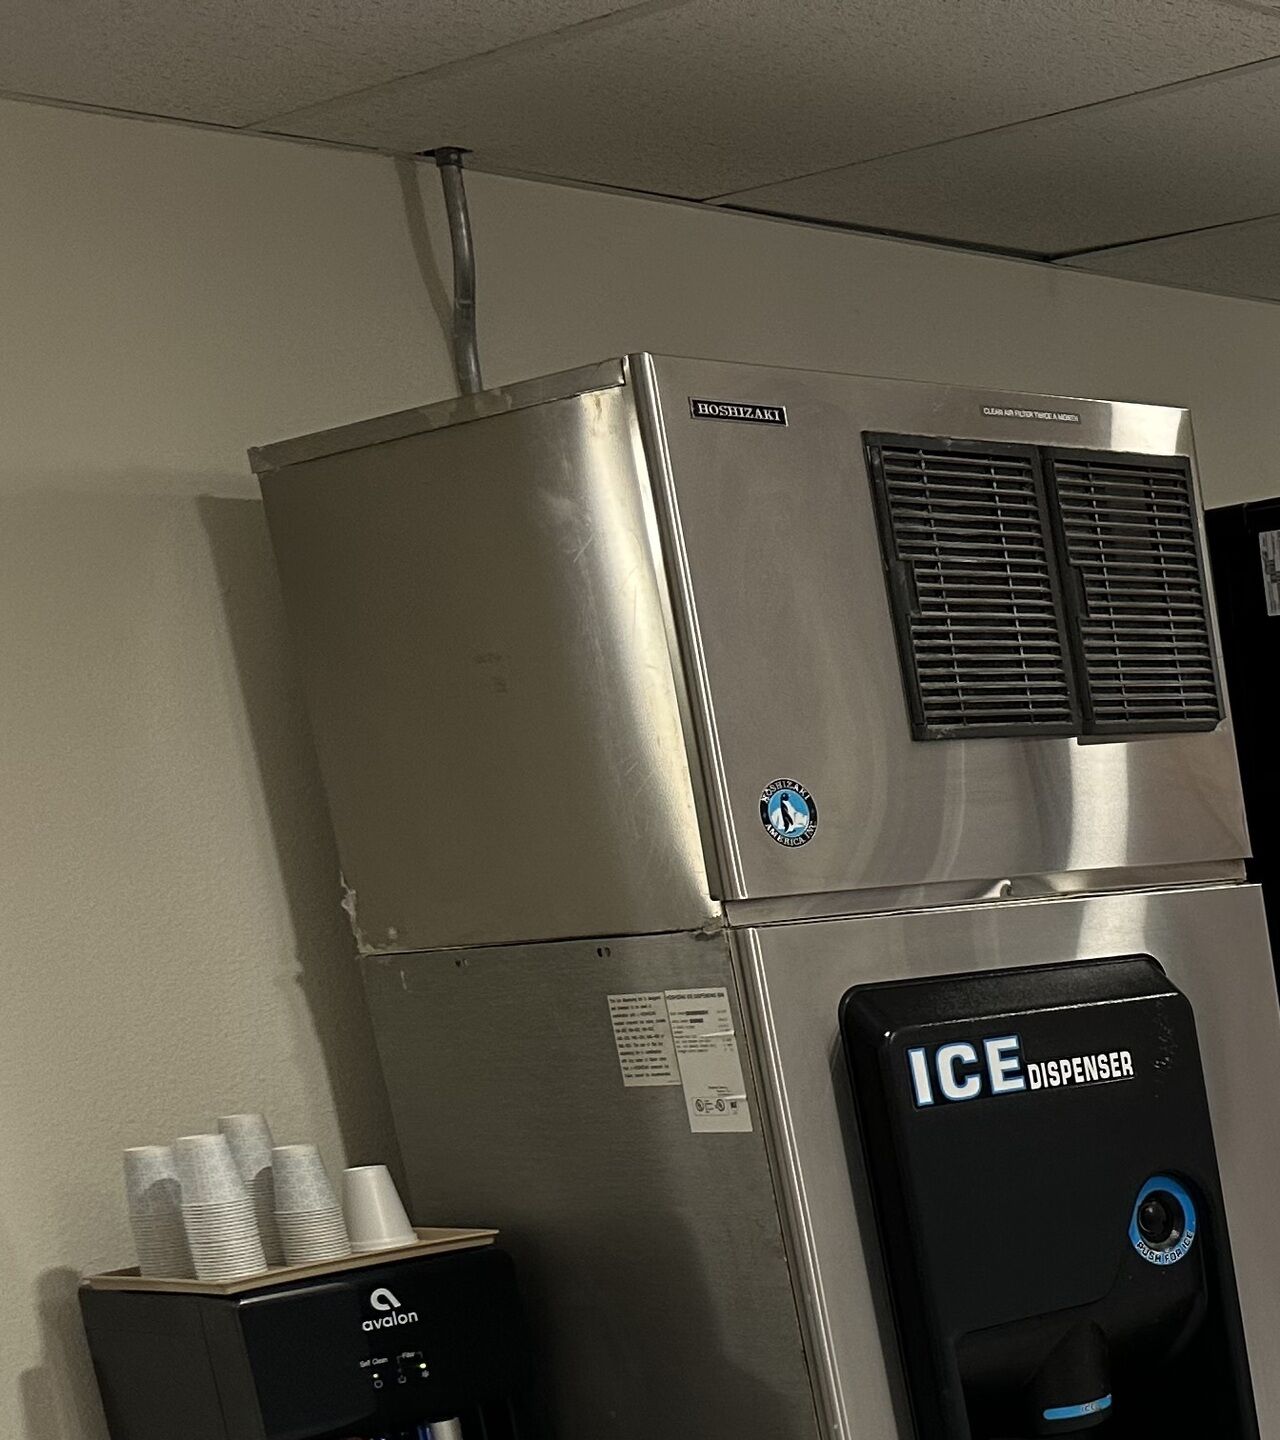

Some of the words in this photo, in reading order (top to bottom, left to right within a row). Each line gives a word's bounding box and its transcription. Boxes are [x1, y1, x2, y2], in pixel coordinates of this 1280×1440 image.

[698, 403, 781, 421] HOSHIZAKI
[760, 781, 810, 803] HOSHIZAKI
[765, 824, 804, 846] AMERICA
[908, 1035, 1026, 1107] ICE
[1027, 1050, 1134, 1090] DISPENSER
[1137, 1241, 1161, 1262] PUSH
[1164, 1248, 1182, 1262] FOR
[1181, 1230, 1193, 1249] ICE
[362, 1310, 419, 1332] avalon
